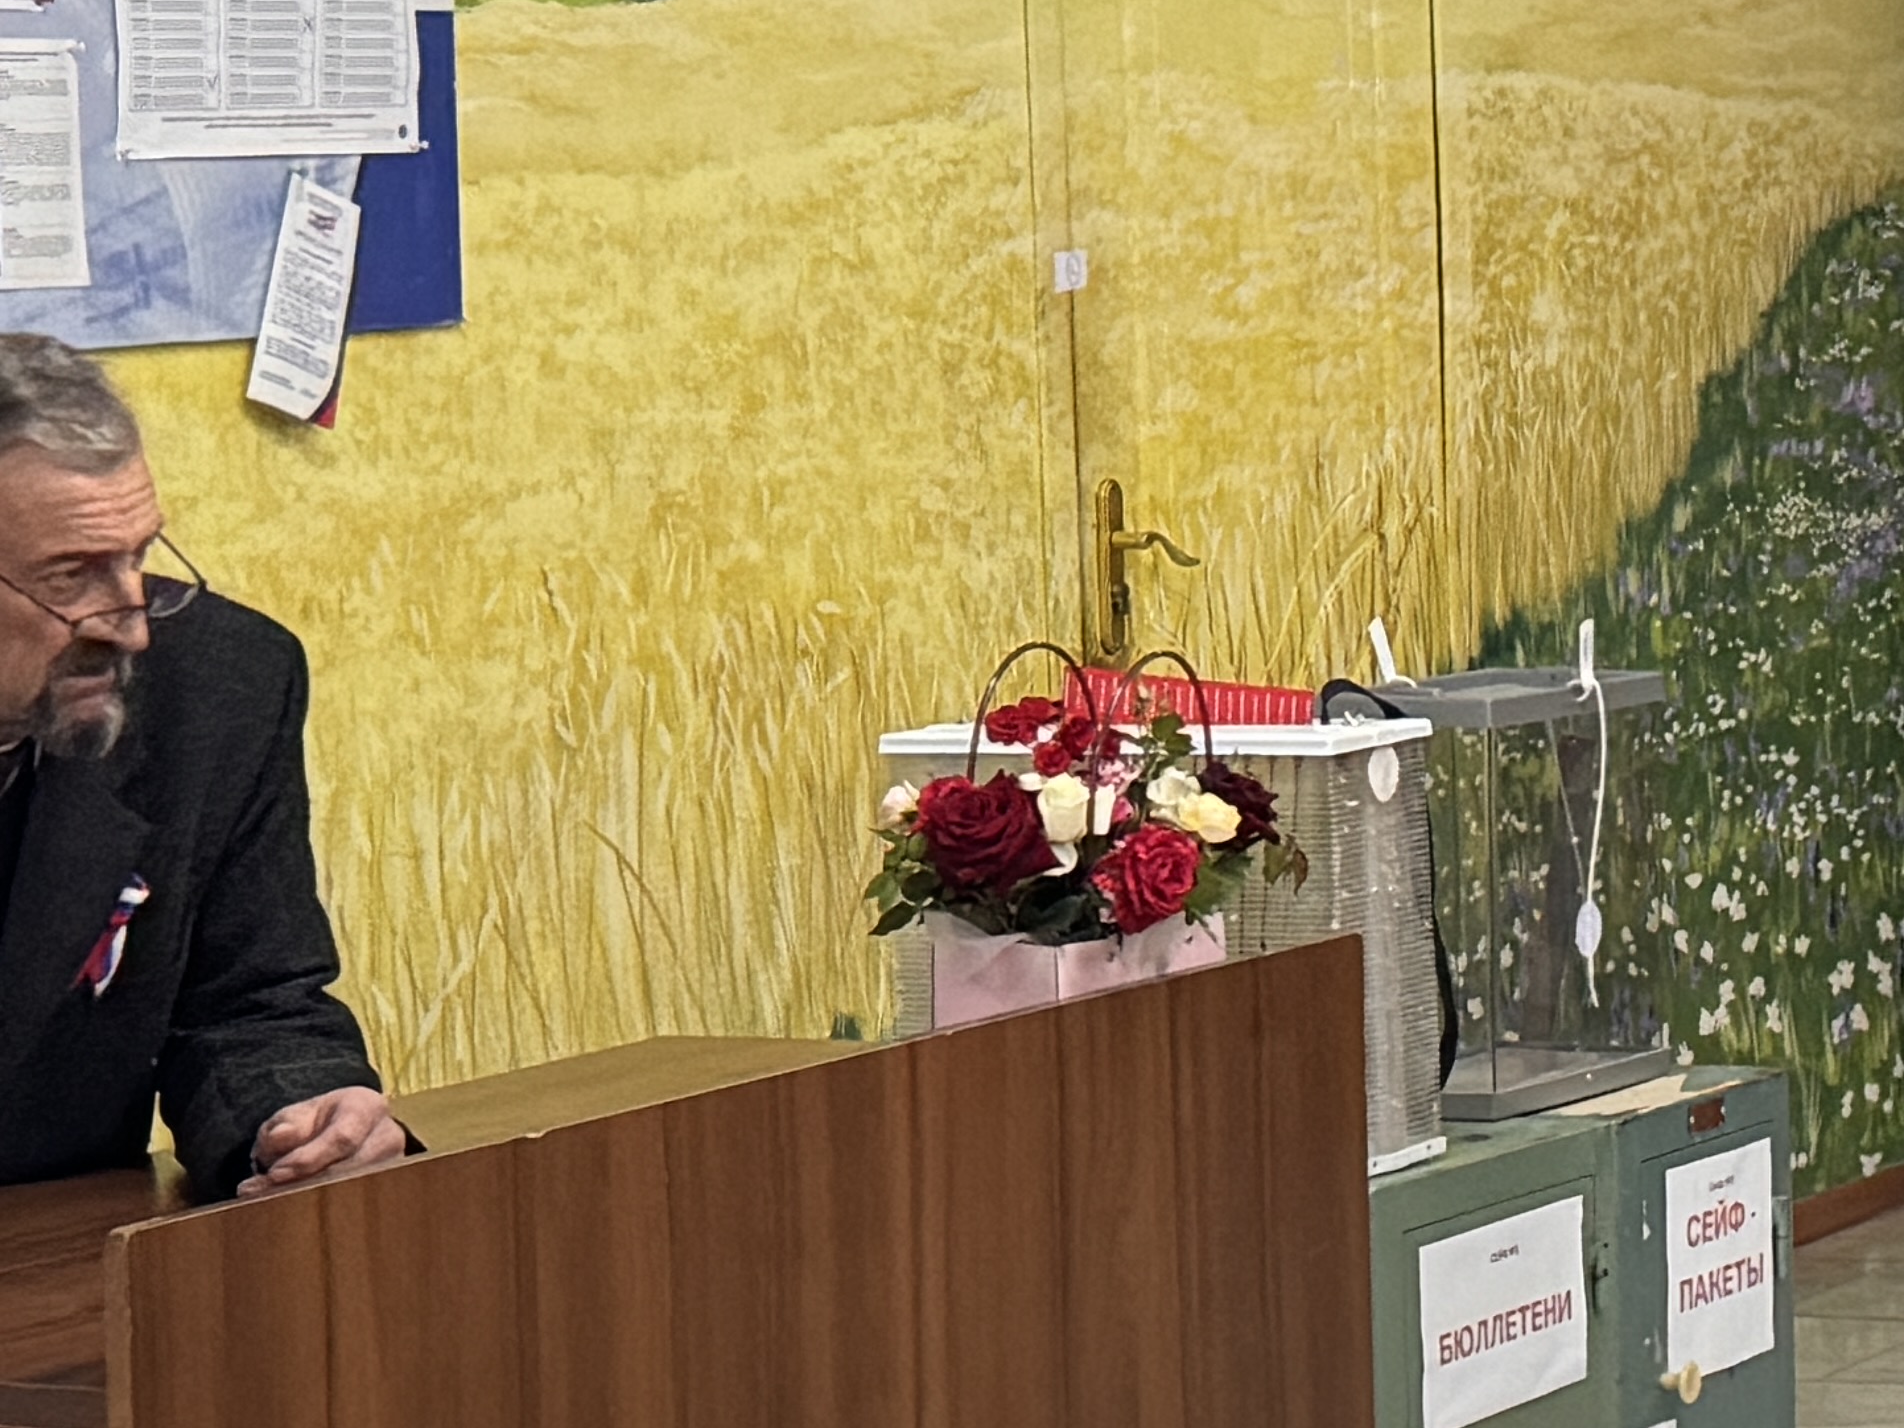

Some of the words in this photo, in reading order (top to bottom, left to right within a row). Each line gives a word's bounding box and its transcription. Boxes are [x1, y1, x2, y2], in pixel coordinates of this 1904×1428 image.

[1687, 1199, 1745, 1248] СЕЙФ
[1680, 1253, 1763, 1313] ПАКЕТЫ
[1439, 1290, 1572, 1366] БЮЛЛЕТЕНИ
